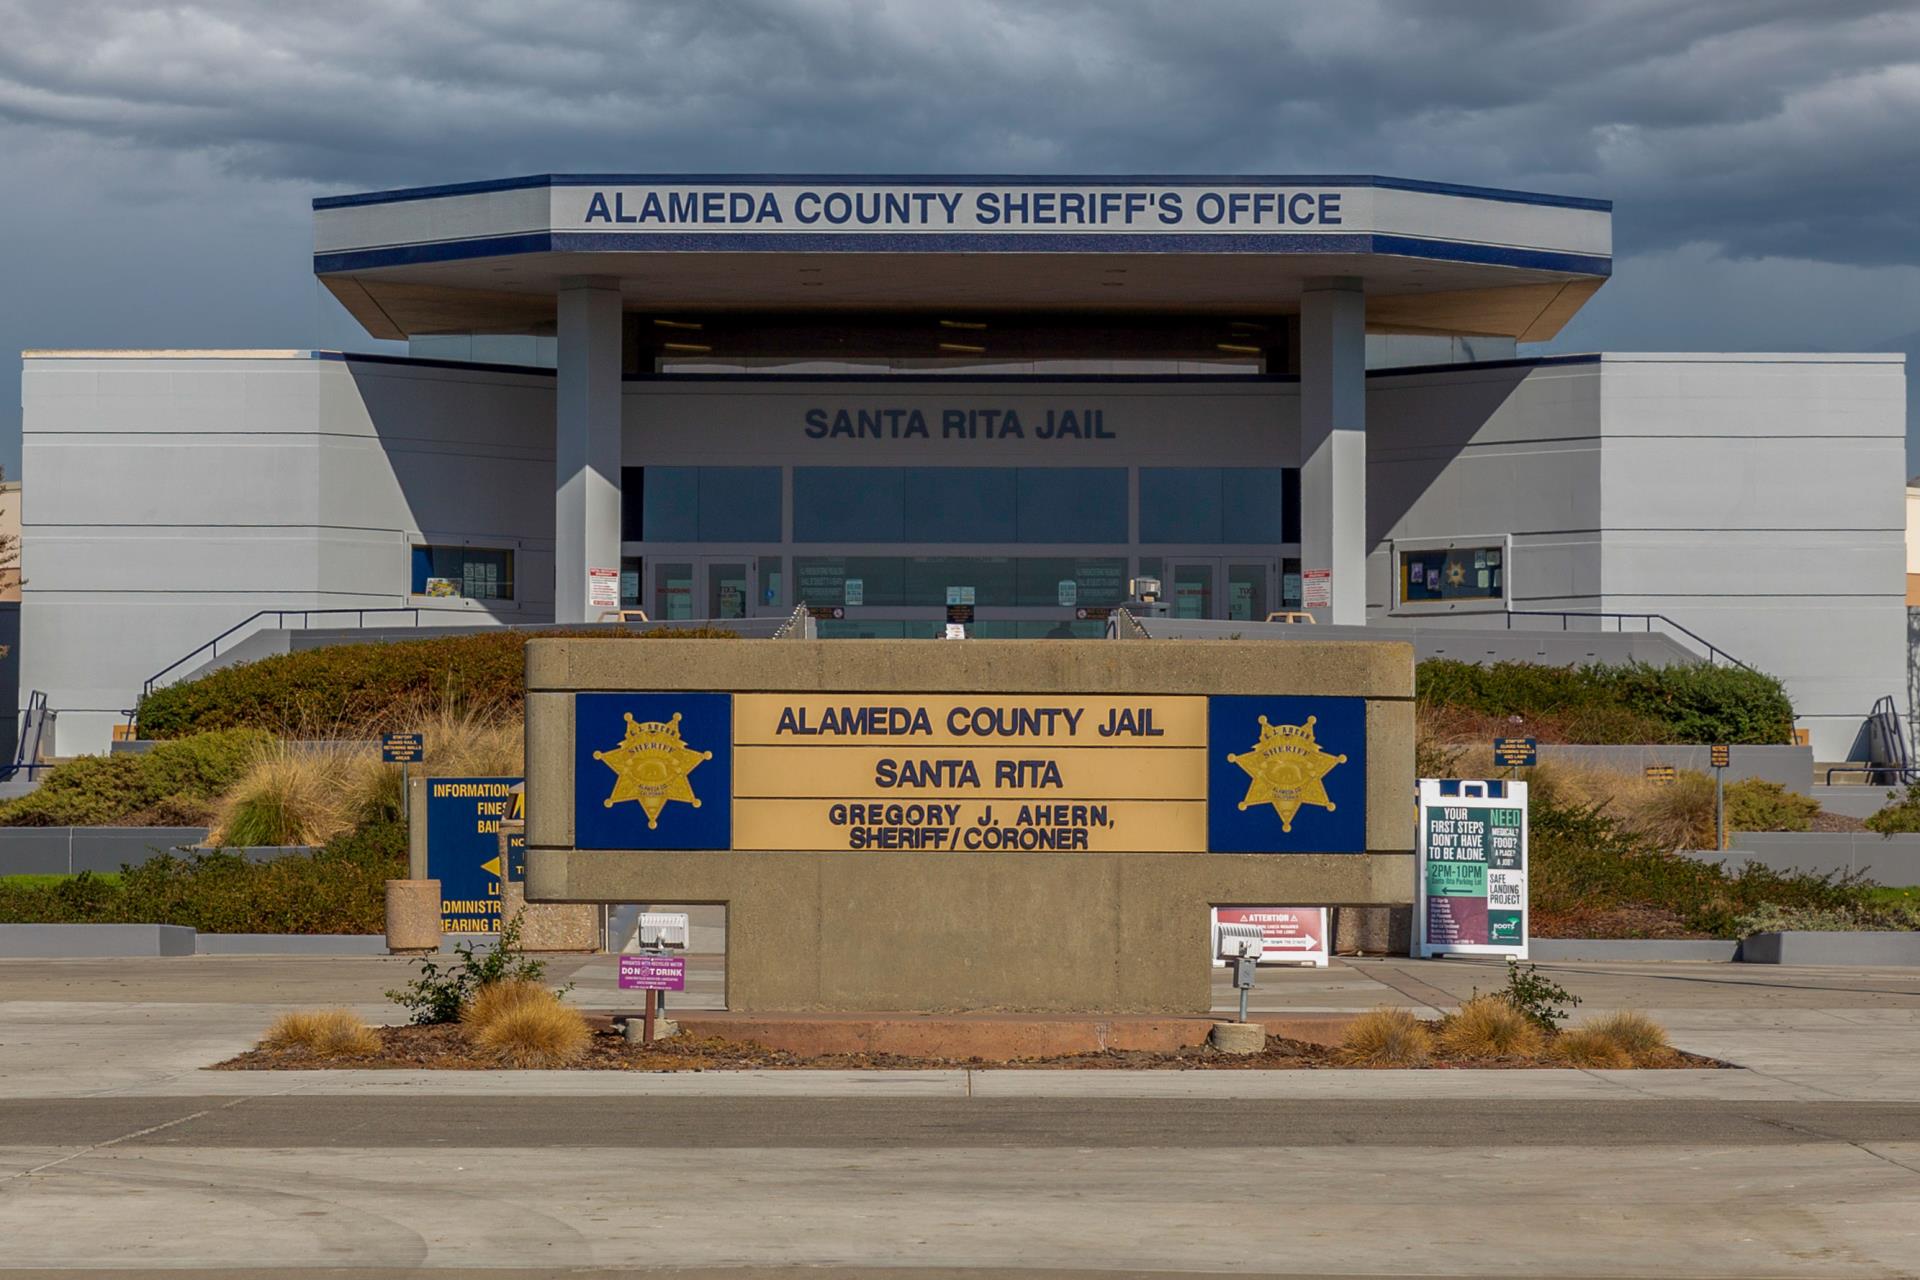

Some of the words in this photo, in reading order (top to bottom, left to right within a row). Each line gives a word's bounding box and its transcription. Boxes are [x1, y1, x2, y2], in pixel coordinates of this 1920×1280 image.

[584, 191, 784, 223] ALAMEDA
[794, 191, 964, 224] COUNTY
[975, 192, 1184, 225] SHERIFF'S
[1195, 192, 1342, 225] OFFICE
[804, 408, 931, 439] SANTA
[942, 409, 1025, 439] RITA
[1035, 409, 1117, 439] JAIL
[776, 706, 934, 736] ALAMEDA
[946, 706, 1085, 737] COUNTY
[1098, 707, 1165, 737] JAIL
[628, 743, 677, 754] SHERIFF
[1263, 745, 1311, 759] SHERIFF
[875, 758, 981, 789] SANTA
[995, 760, 1064, 789] RITA
[433, 783, 510, 798] INFORMATION
[829, 803, 961, 826] GREGORY
[977, 804, 999, 826] J.
[1015, 804, 1115, 829] AHERN,
[1443, 807, 1468, 820] YOUR
[1490, 809, 1521, 827] NEED
[1431, 820, 1455, 833] FIRST
[1457, 821, 1484, 834] STEPS
[1491, 828, 1520, 837] MEDICAL?
[1432, 833, 1459, 847] DON'T
[1461, 834, 1483, 847] HAVE
[1493, 837, 1518, 849] FOOD?
[1429, 846, 1441, 860] TO
[1443, 847, 1455, 860] BE
[1456, 847, 1486, 861] ALONE.
[1501, 859, 1515, 867] JOB?
[1431, 864, 1482, 878] 2PM-10PM
[1456, 878, 1473, 886] Parking
[1489, 873, 1506, 884] SAFE
[1489, 884, 1520, 895] LANDING
[1489, 894, 1521, 905] PROJECT
[441, 900, 501, 914] DMINISTR
[1248, 913, 1290, 922] ATTENTION
[621, 967, 633, 975] DO
[656, 968, 683, 977] DRINK
